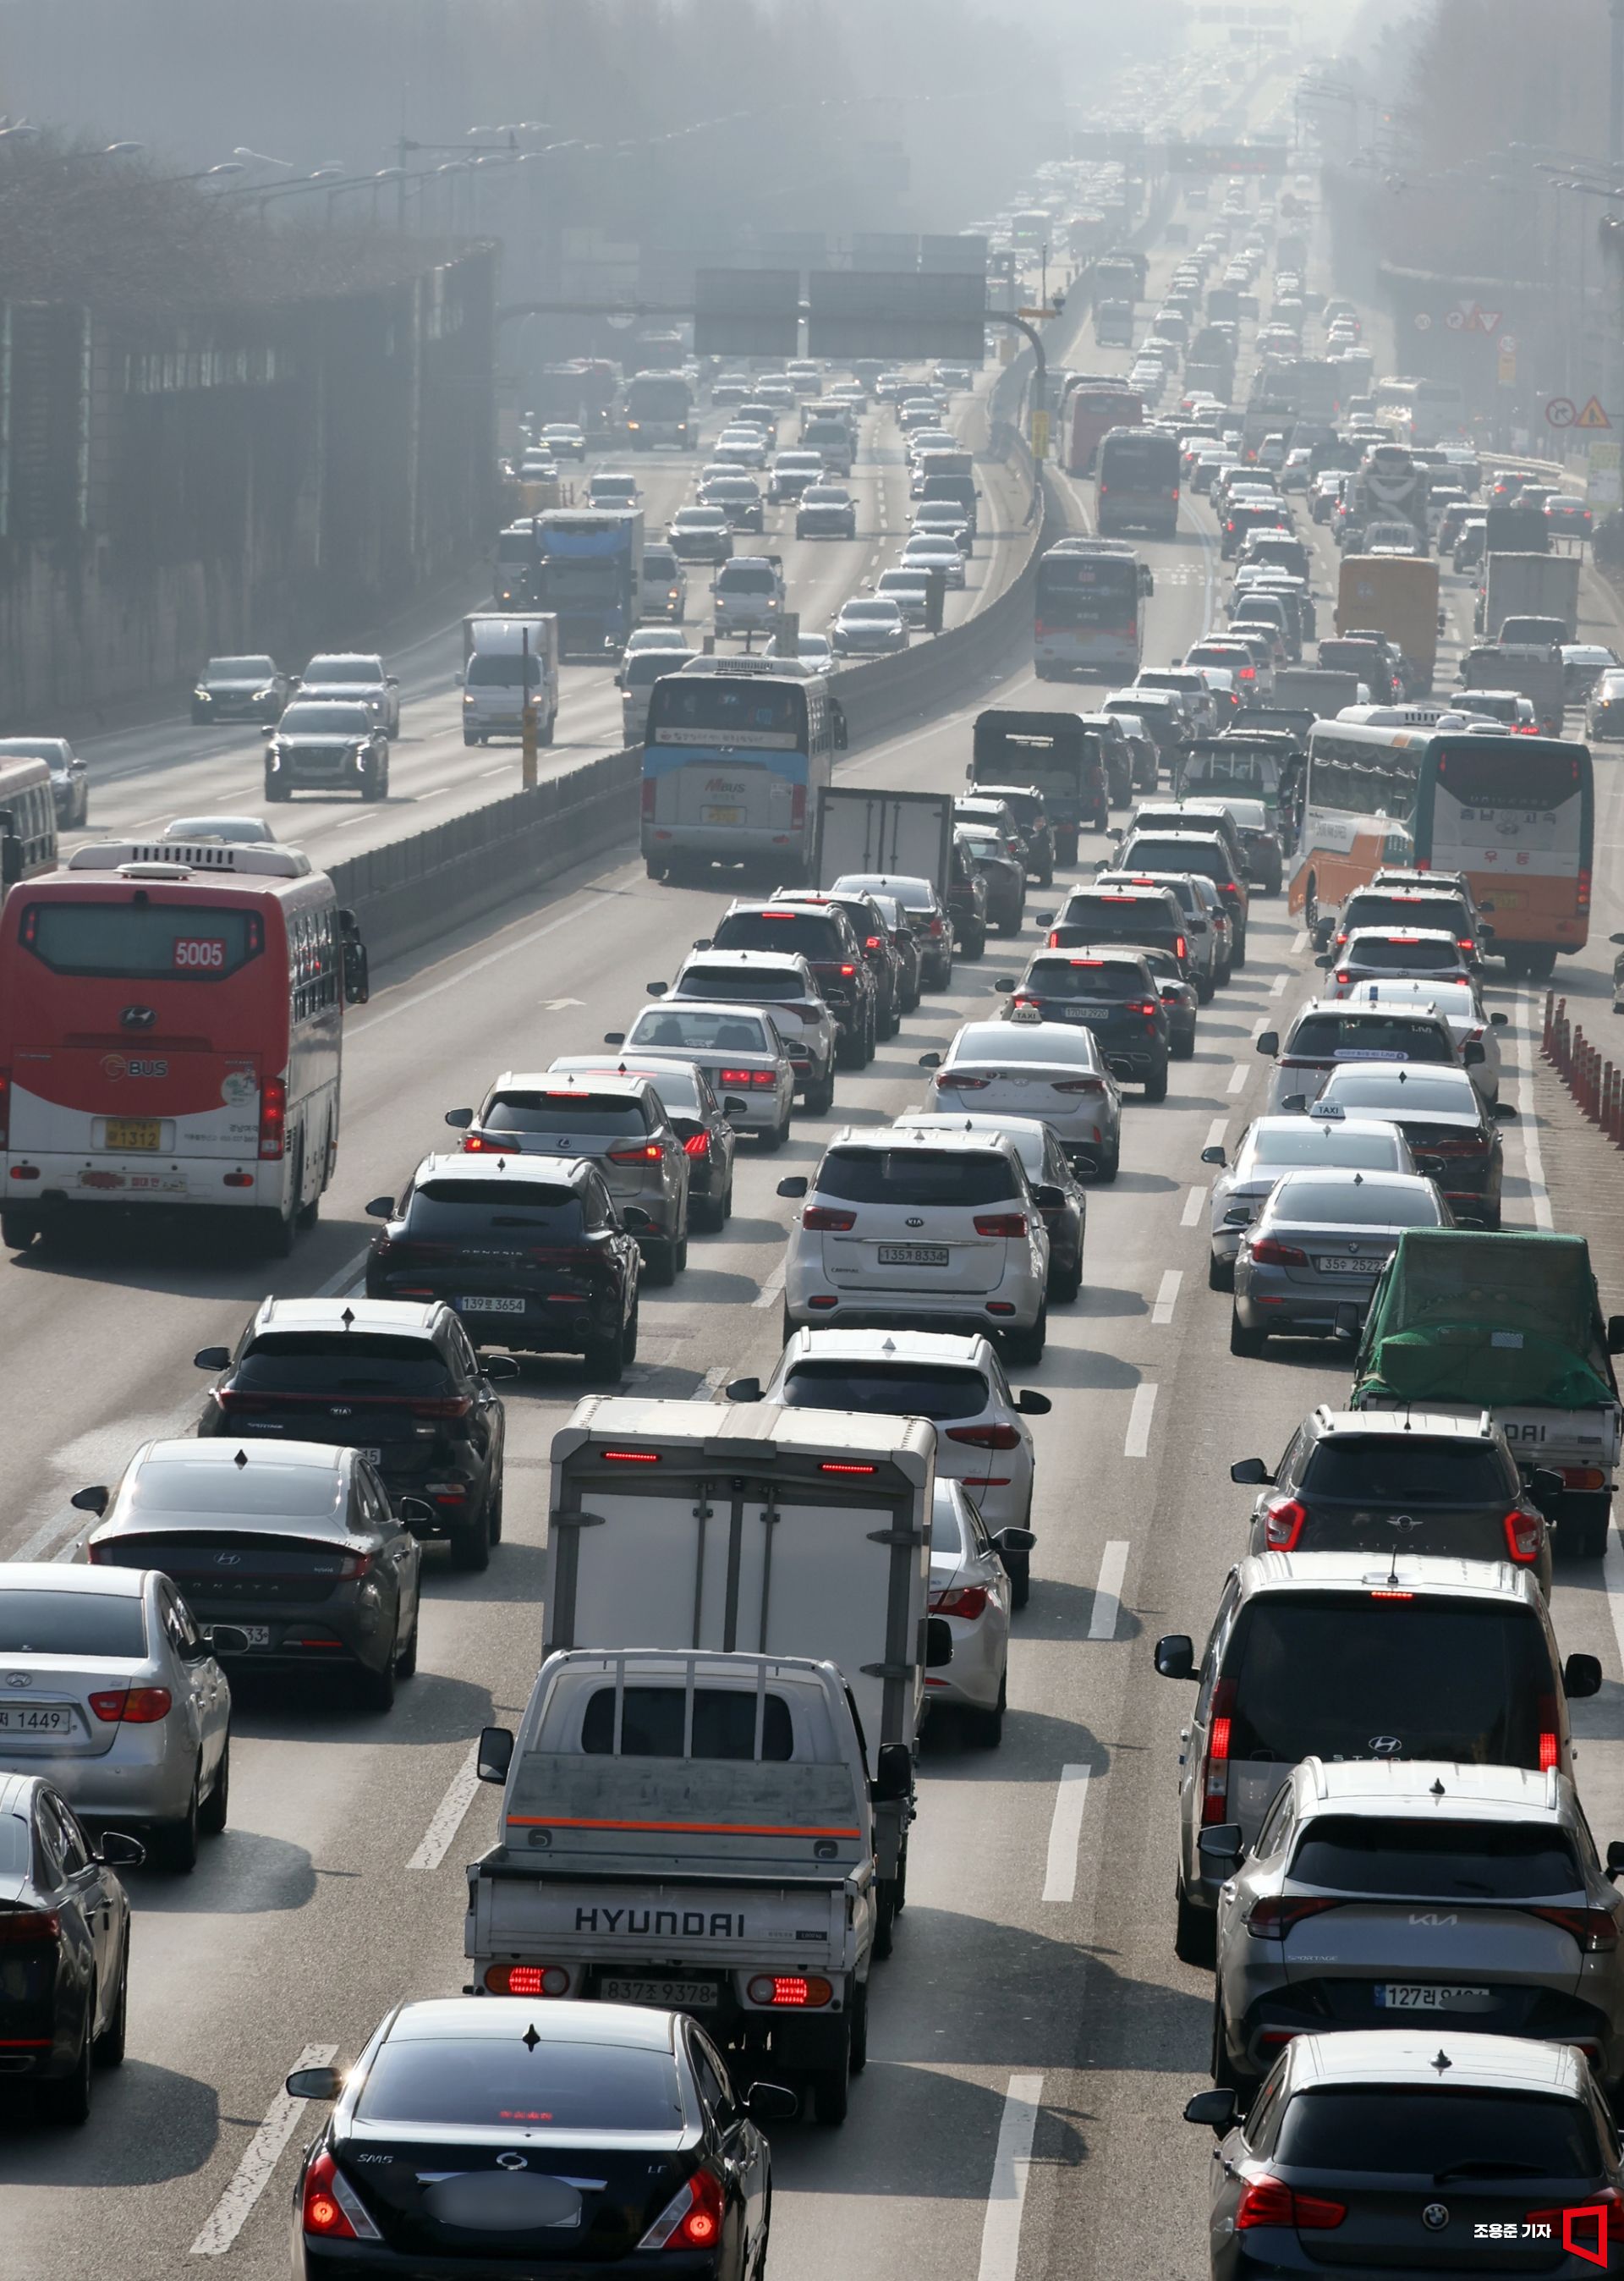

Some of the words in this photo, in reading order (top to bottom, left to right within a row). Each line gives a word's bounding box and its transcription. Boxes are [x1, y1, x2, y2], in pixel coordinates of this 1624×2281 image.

[176, 942, 223, 966] 5005
[1319, 1106, 1339, 1114] TAXI
[915, 1250, 944, 1261] 8334
[1352, 1260, 1380, 1271] 2522
[495, 1300, 523, 1311] 3654
[18, 1712, 60, 1729] 1449
[575, 1907, 745, 1937] HYUNDAI
[1408, 1913, 1457, 1926] KIA
[607, 1981, 657, 2001] 837조
[662, 1982, 710, 2003] 9378
[357, 2153, 394, 2164] SM5
